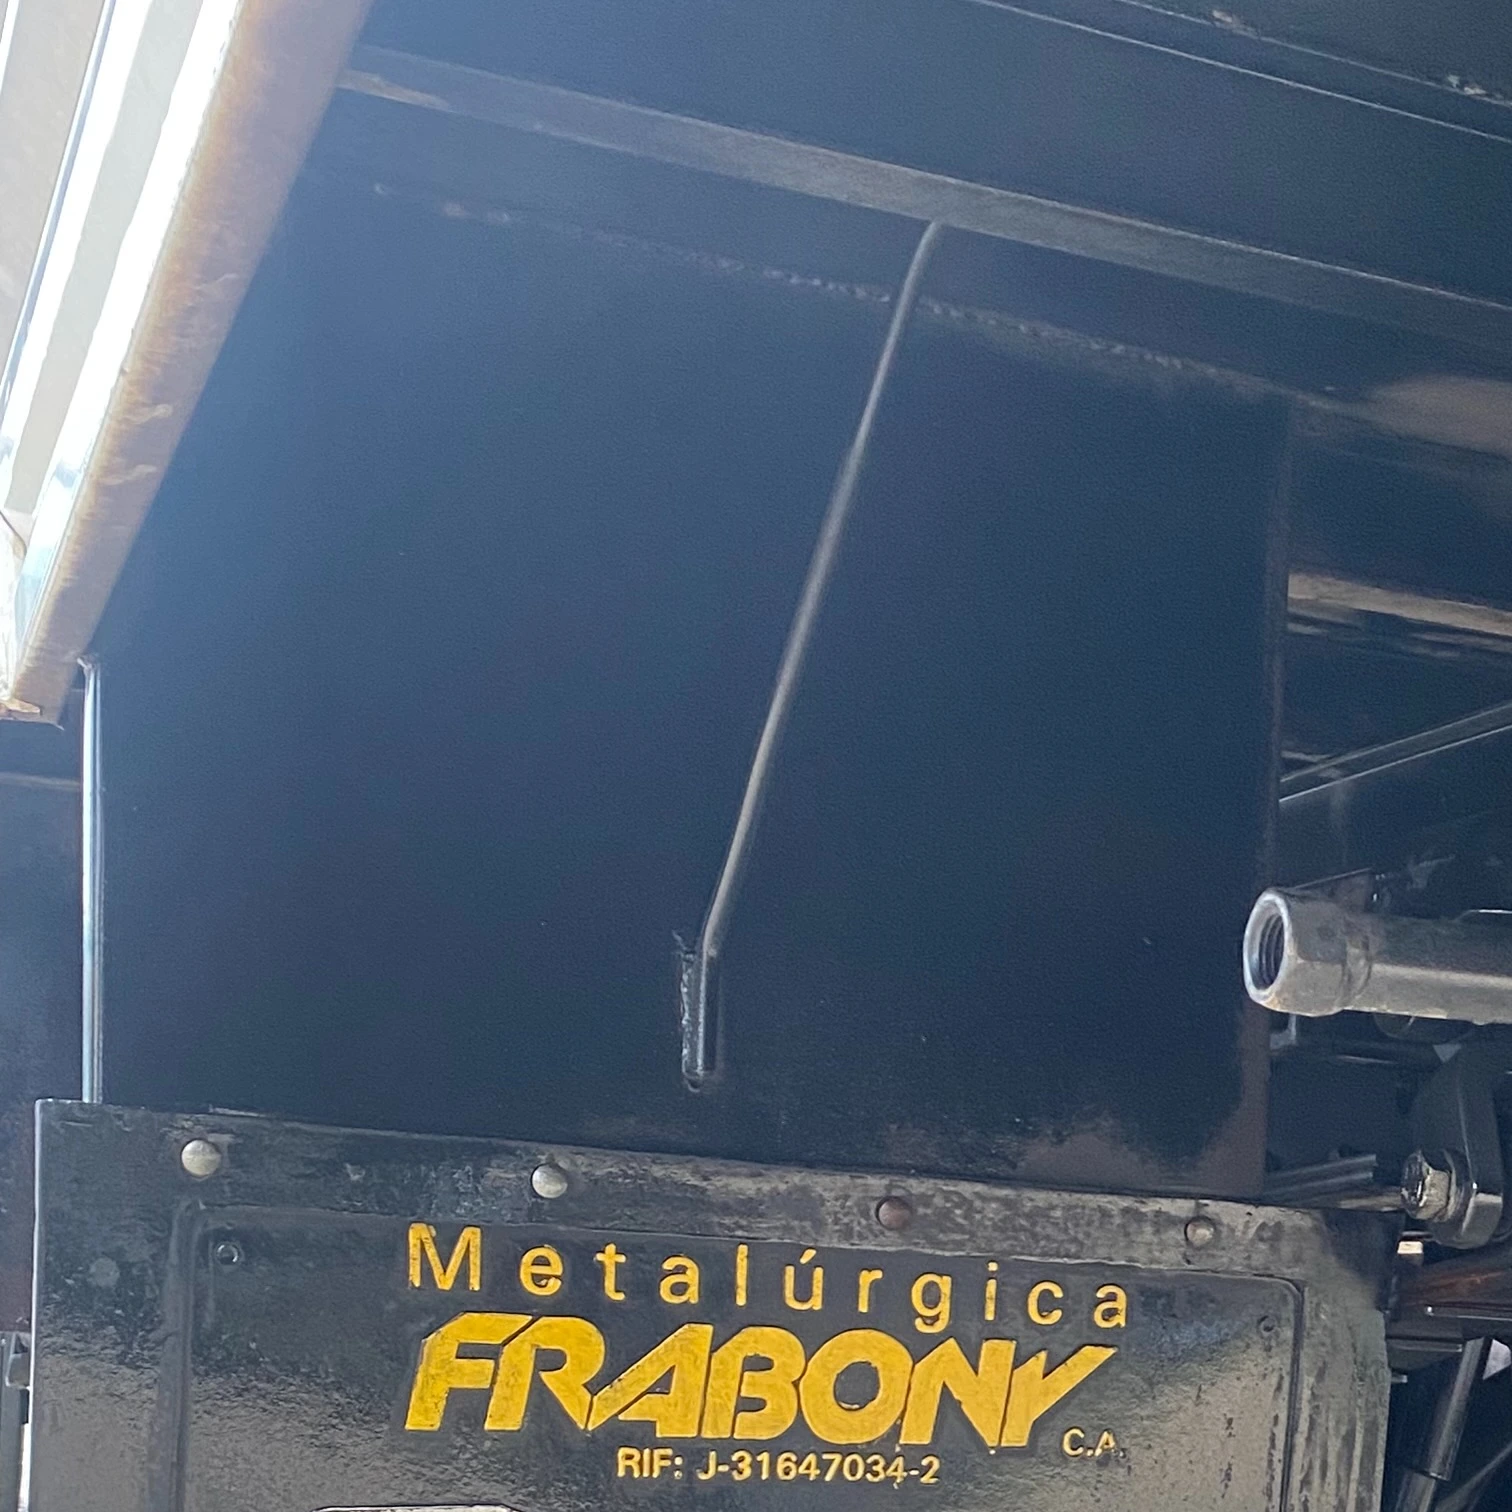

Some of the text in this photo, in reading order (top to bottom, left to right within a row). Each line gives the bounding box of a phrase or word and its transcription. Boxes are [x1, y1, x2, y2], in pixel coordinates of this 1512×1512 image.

[407, 1221, 1129, 1334] Metalúrgica
[404, 1311, 1118, 1447] FRABONY
[617, 1446, 940, 1486] RIF: J-31647034-2
